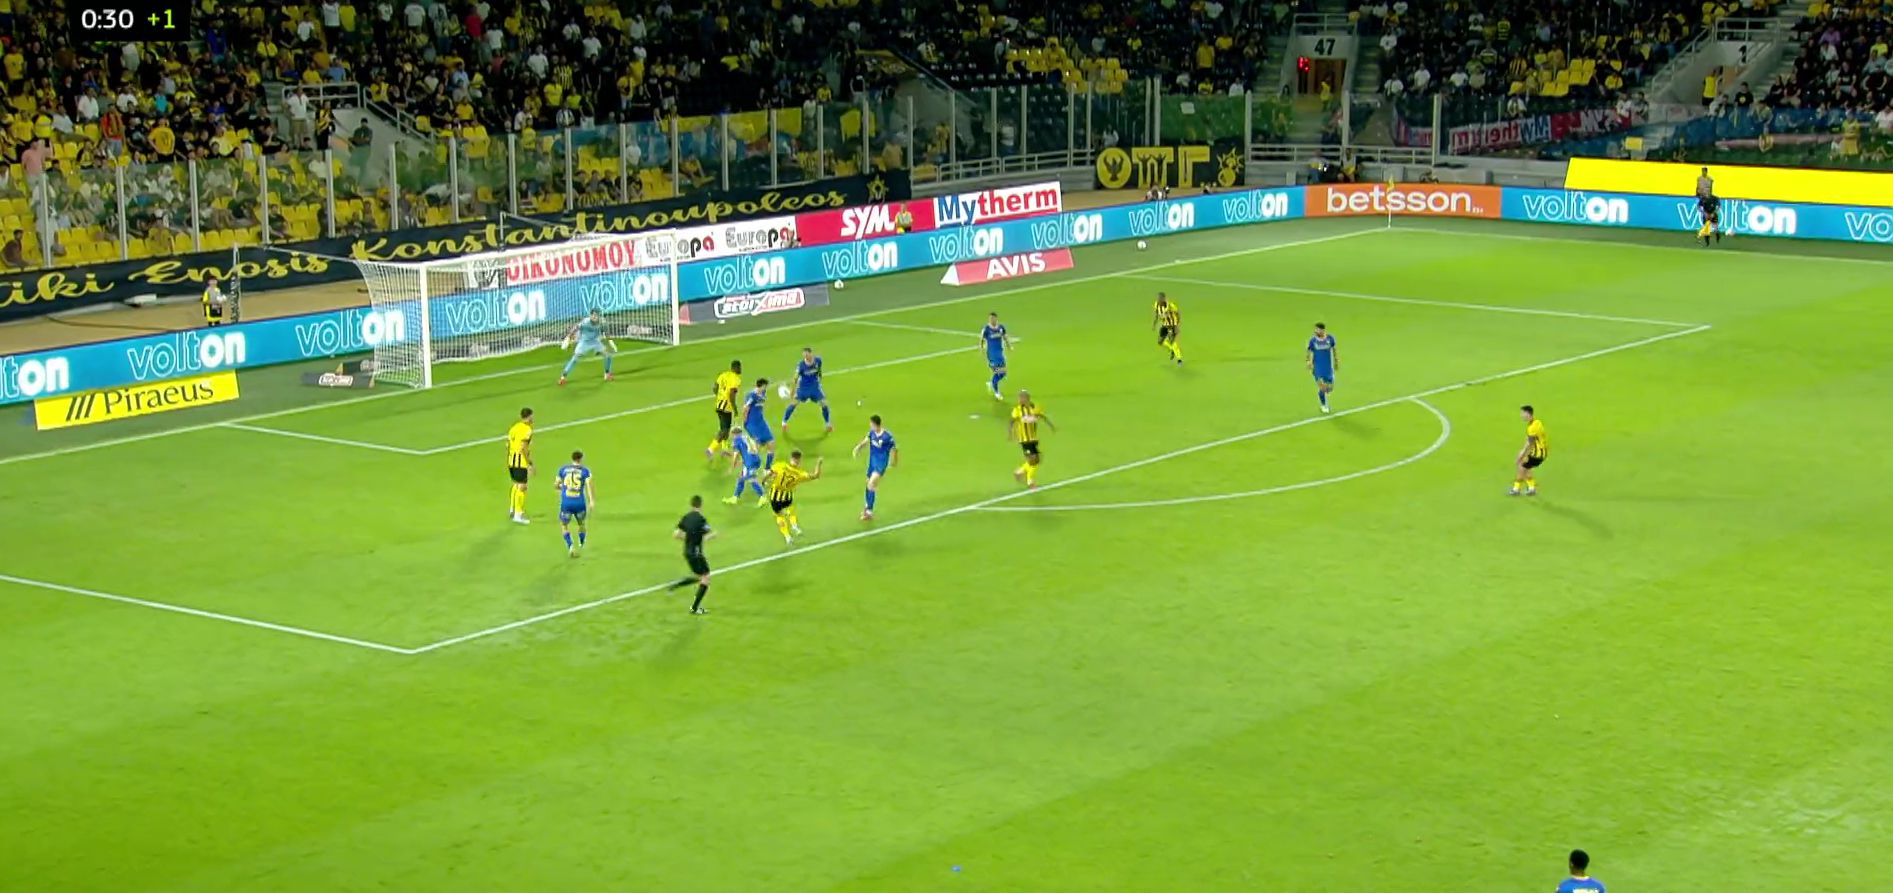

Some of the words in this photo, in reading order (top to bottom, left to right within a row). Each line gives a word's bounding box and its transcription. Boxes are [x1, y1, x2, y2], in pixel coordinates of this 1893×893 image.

[1314, 38, 1336, 56] 47
[938, 187, 1058, 226] Mytherm
[1223, 189, 1288, 224] volton
[1326, 185, 1472, 213] betsson
[1522, 191, 1629, 224] volton
[841, 206, 896, 239] SYM
[1031, 213, 1103, 250] volton
[1129, 201, 1195, 236] volton
[645, 235, 715, 258] Euopa
[821, 239, 898, 279] volton
[928, 226, 1003, 263] volton
[128, 252, 329, 284] Enosis
[704, 256, 785, 296] volton
[987, 252, 1046, 280] AVIS
[581, 270, 669, 313] volton
[446, 288, 546, 334] volton
[296, 309, 405, 357] volton
[128, 330, 246, 380] volton
[105, 380, 214, 414] Piraeus
[564, 472, 581, 490] 45
